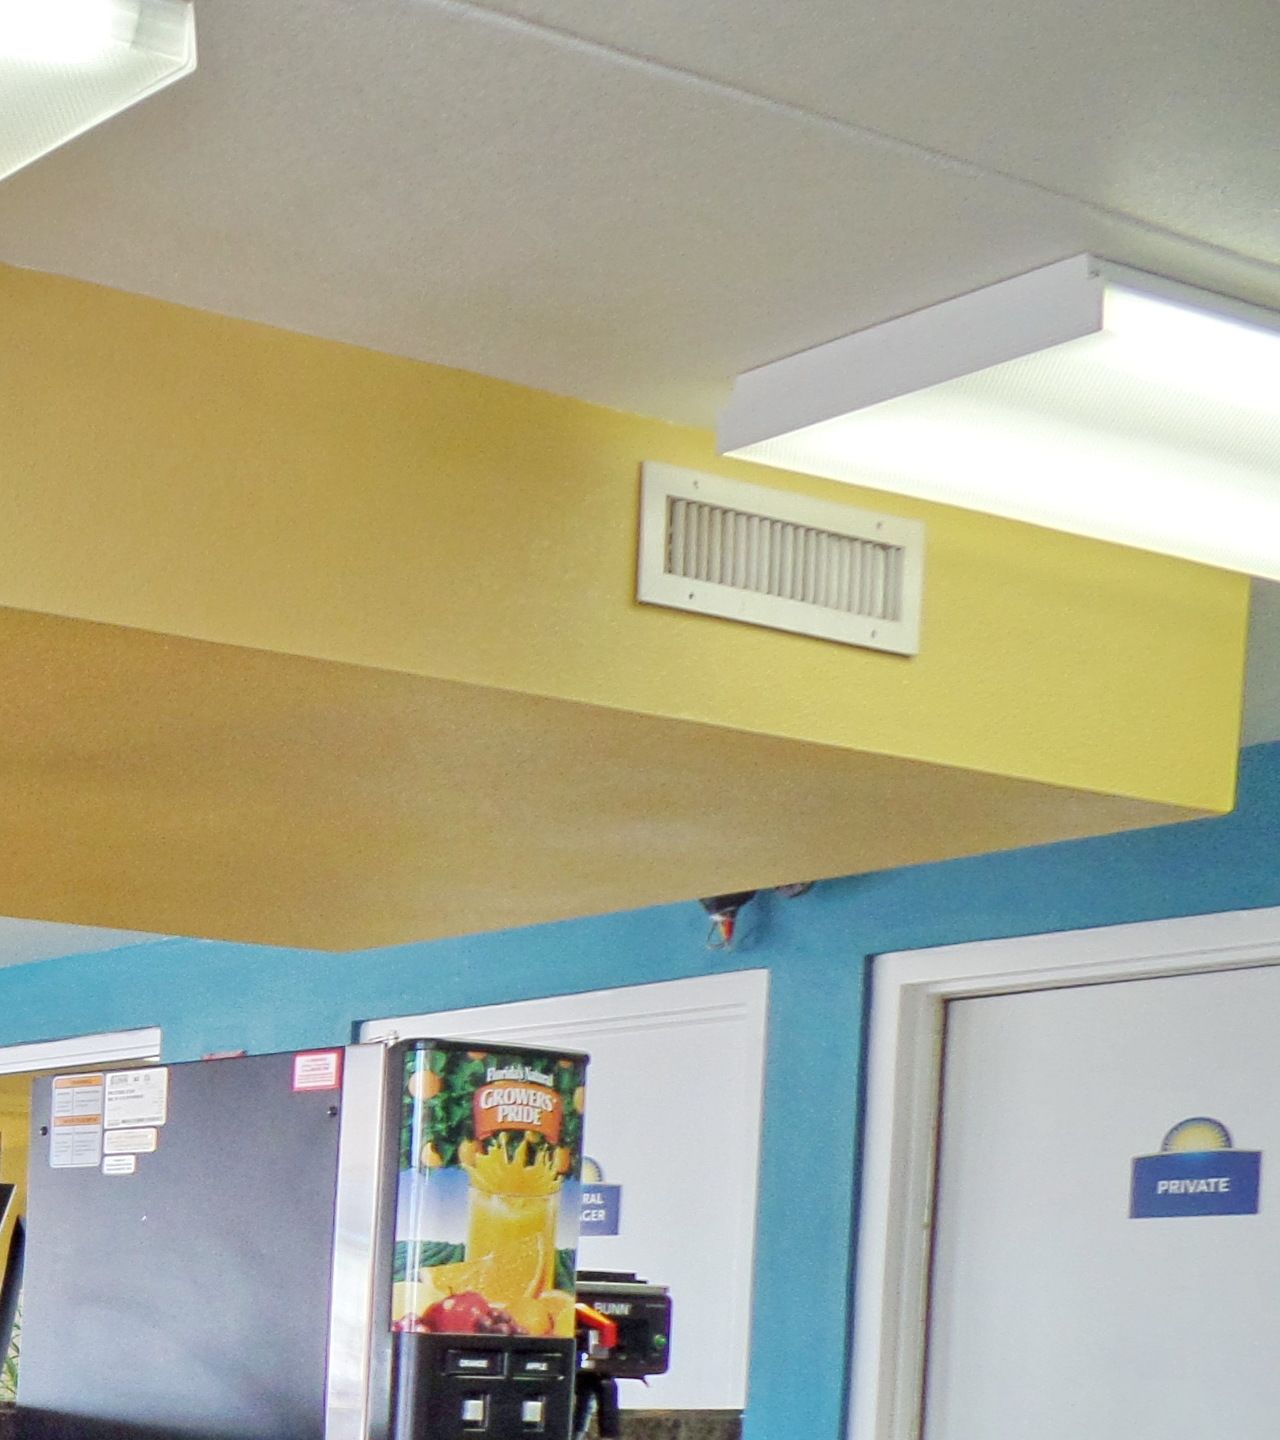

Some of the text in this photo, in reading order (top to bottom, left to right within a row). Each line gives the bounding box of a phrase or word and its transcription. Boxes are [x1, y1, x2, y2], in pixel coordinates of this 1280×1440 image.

[497, 1105, 542, 1125] PRIDE
[1156, 1177, 1231, 1195] PRIVATE
[582, 1193, 605, 1205] RAL
[594, 1302, 629, 1316] BUNN
